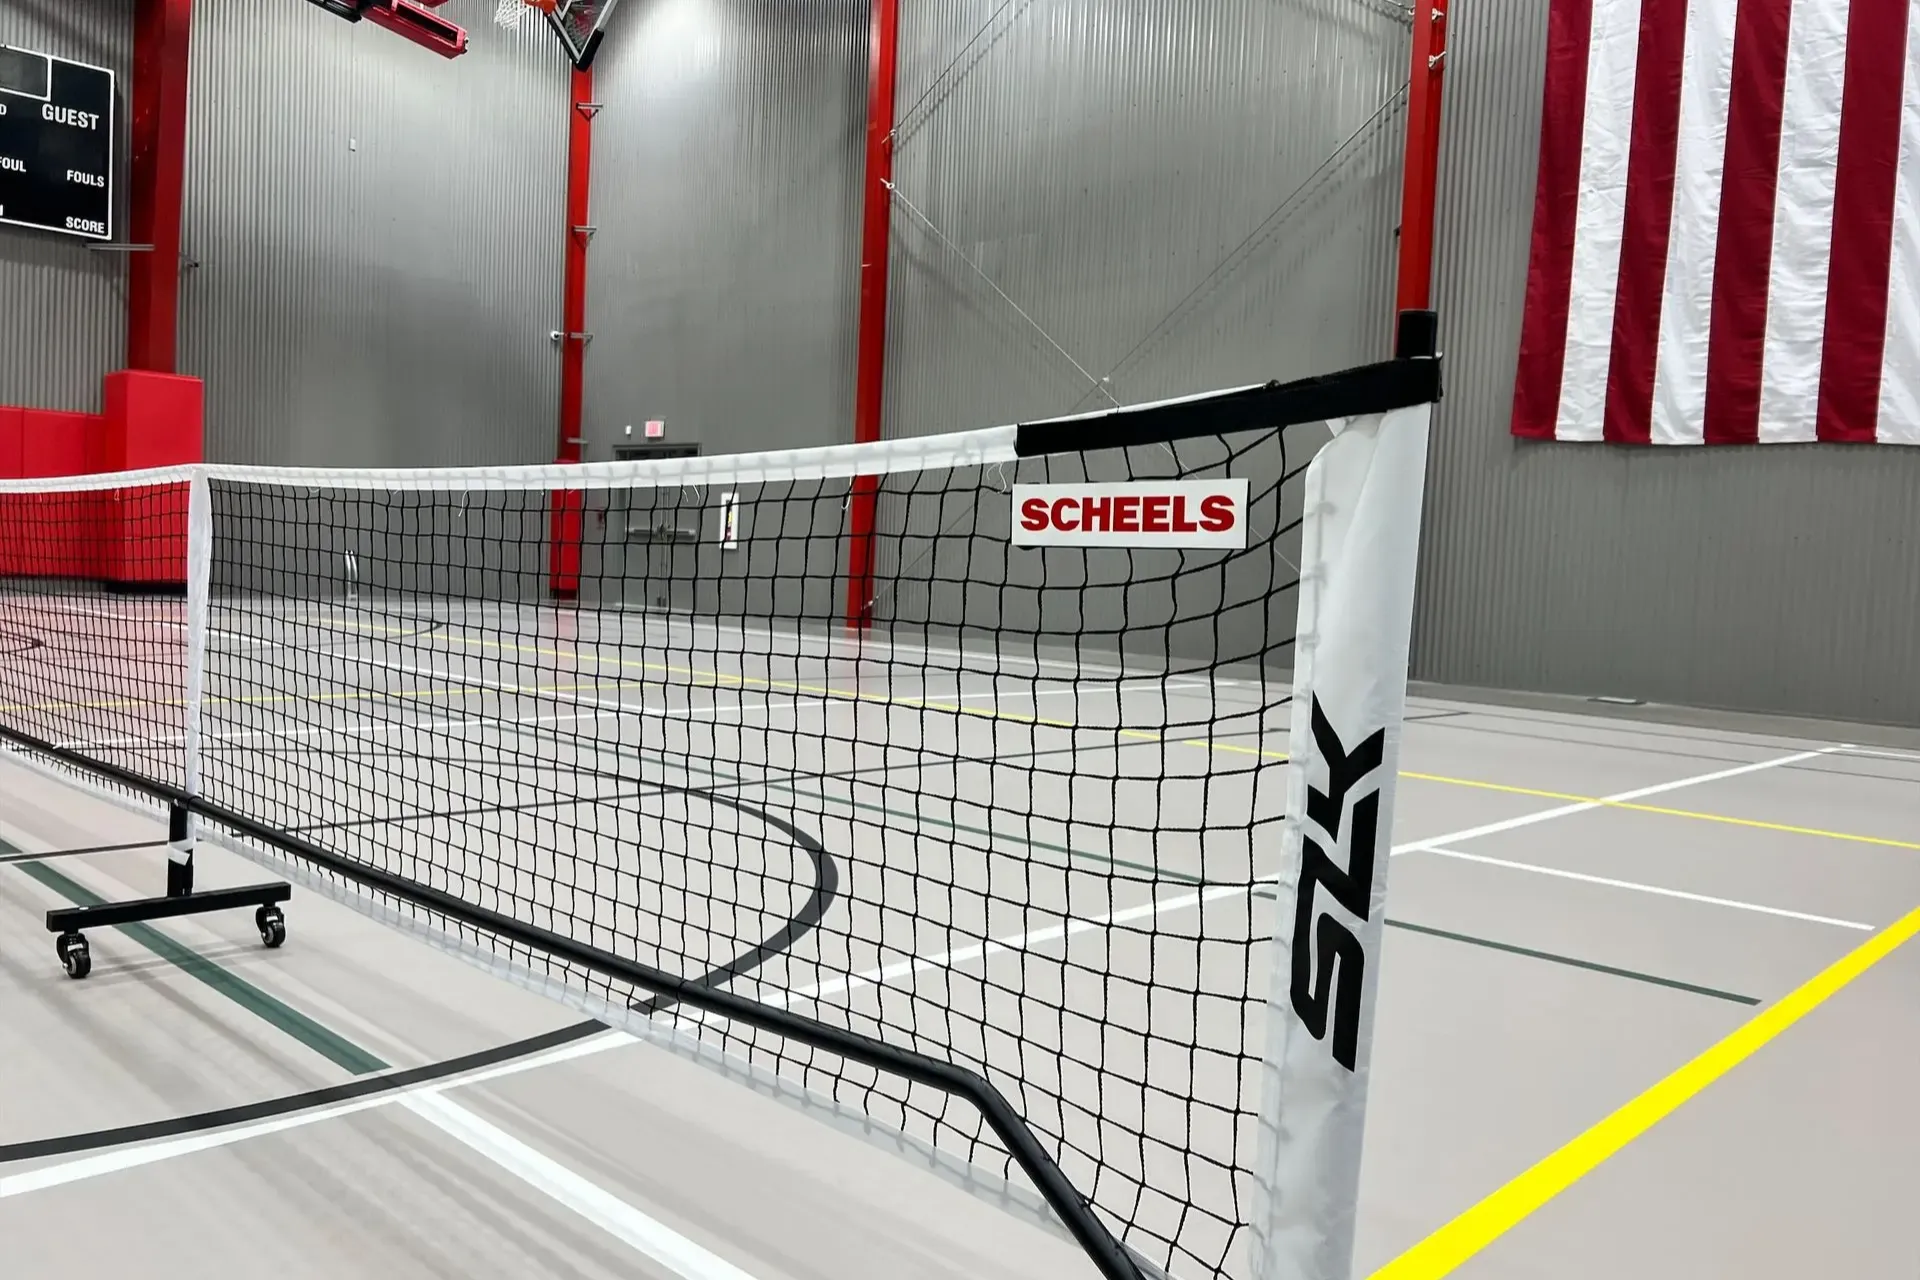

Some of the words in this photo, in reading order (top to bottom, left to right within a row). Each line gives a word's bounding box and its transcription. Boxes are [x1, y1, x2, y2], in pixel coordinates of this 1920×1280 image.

[41, 103, 100, 130] GUEST
[66, 169, 105, 188] FOULS
[65, 216, 105, 234] SCORE
[1020, 495, 1235, 532] SCHEELS
[1290, 690, 1385, 1072] SLK
